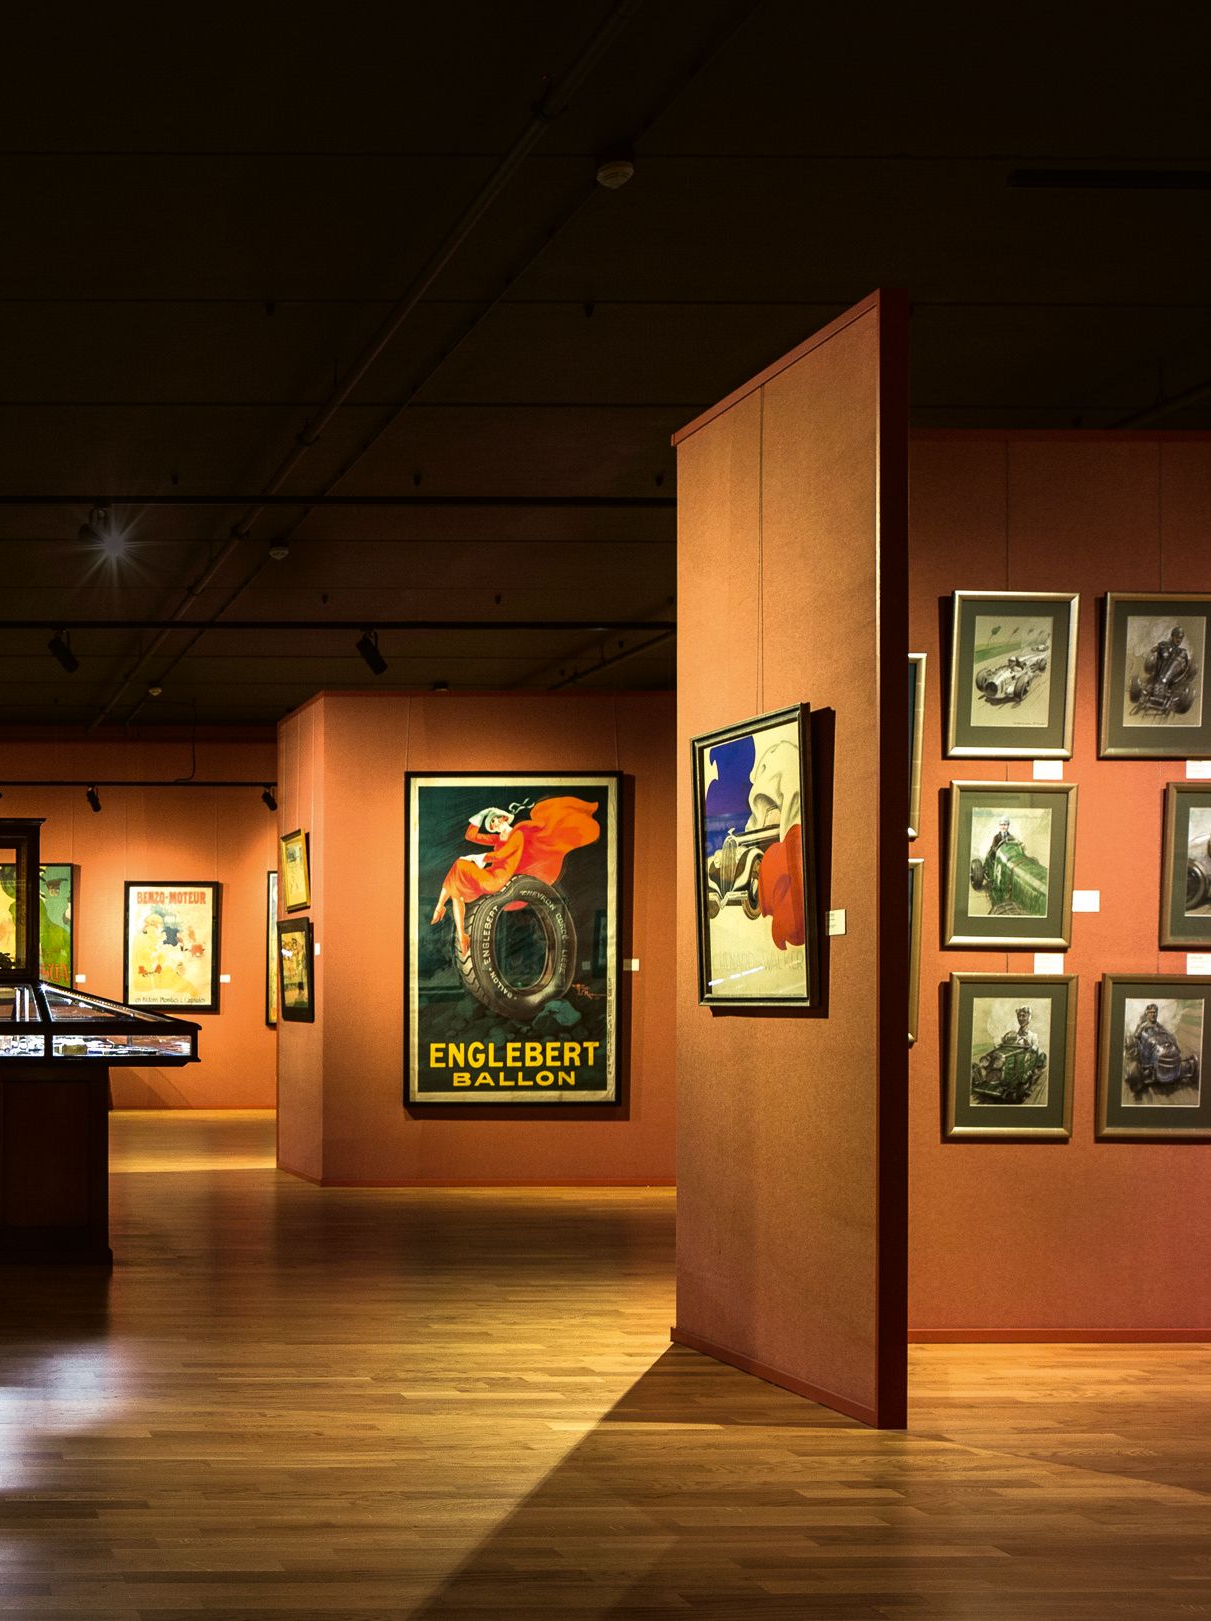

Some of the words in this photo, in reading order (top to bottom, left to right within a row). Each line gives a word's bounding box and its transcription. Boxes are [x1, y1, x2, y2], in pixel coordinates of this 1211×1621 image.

[482, 904, 500, 965] ENGLEBERT
[489, 971, 514, 999] BALLON
[429, 1041, 600, 1069] ENGLEBERT
[453, 1070, 576, 1087] BALLON
